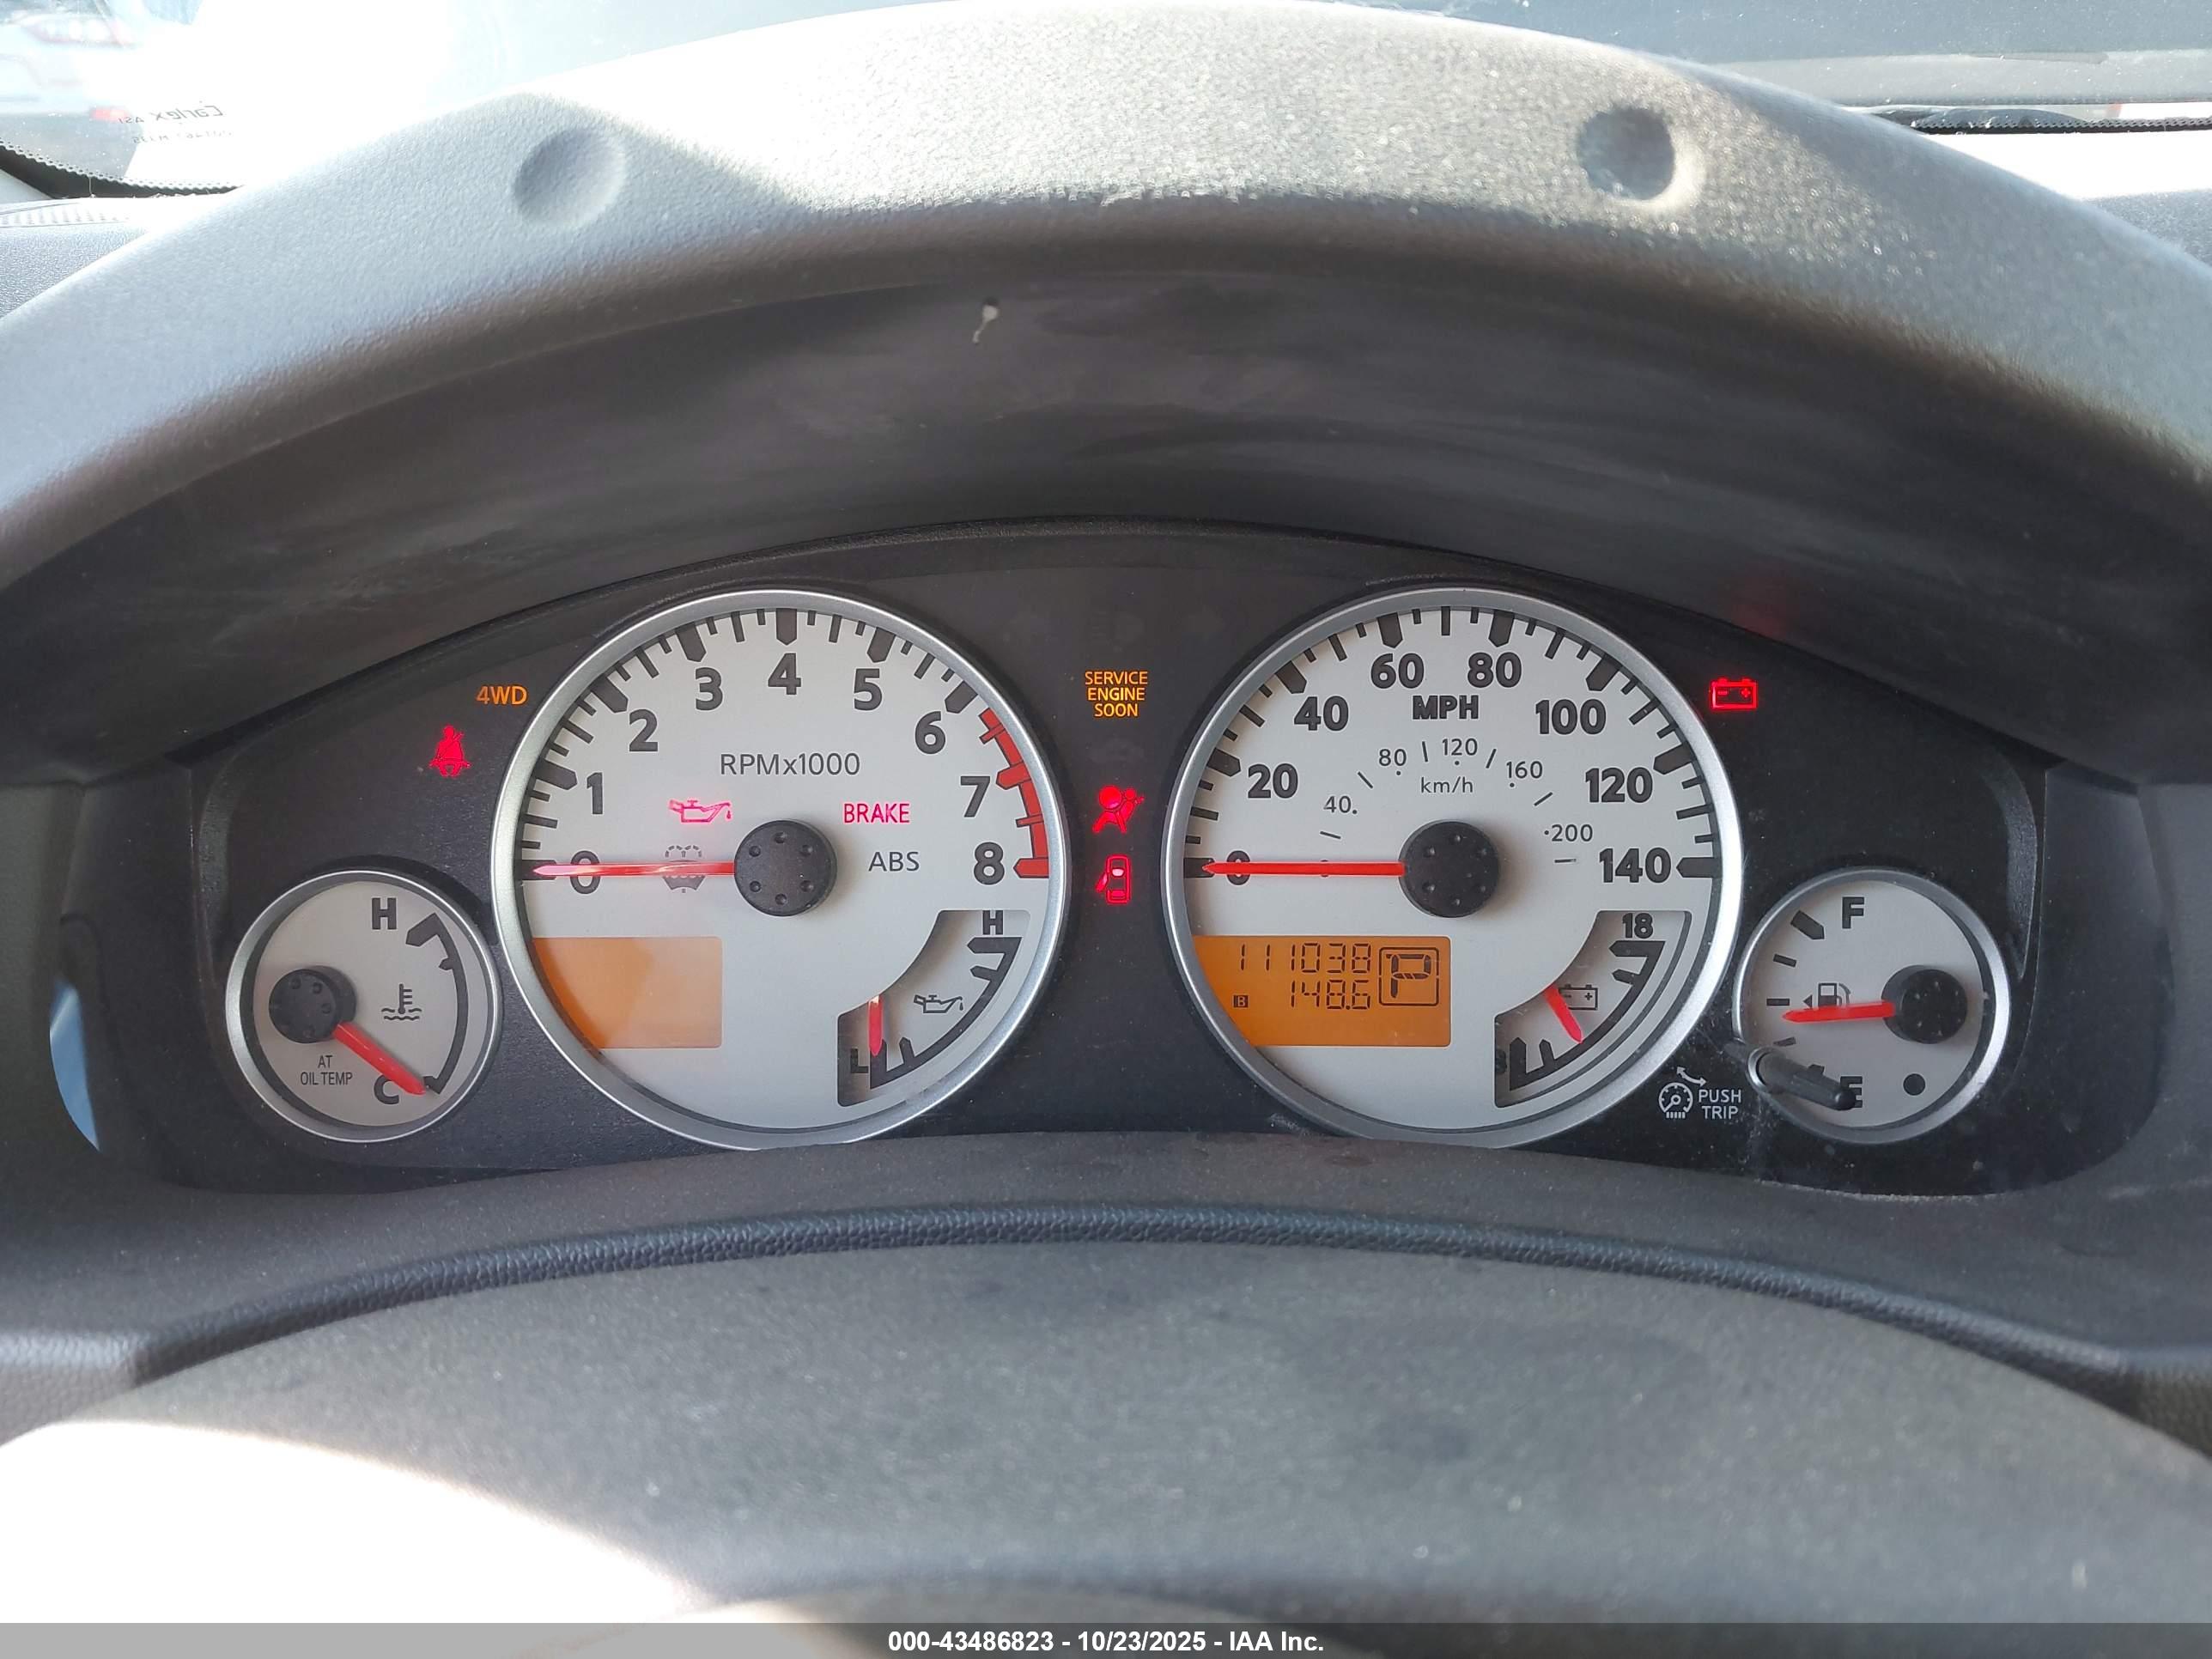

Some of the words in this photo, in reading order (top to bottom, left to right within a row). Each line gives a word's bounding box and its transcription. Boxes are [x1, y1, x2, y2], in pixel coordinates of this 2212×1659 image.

[768, 653, 802, 696] 4
[1085, 671, 1148, 685] SERVICE
[1370, 653, 1425, 689] 60
[1467, 652, 1522, 688] 80
[475, 685, 528, 705] 4WD
[695, 667, 724, 711] 3
[854, 668, 883, 711] 5
[1087, 687, 1146, 701] ENGINE
[1094, 703, 1139, 718] SOON
[1293, 696, 1349, 731] 40
[1413, 695, 1480, 720] MPH
[1535, 699, 1607, 735] 100
[629, 708, 659, 752] 2
[915, 711, 946, 754] 6
[1378, 749, 1407, 766] 80
[1442, 738, 1478, 756] 120
[720, 752, 860, 775] RPMx1000
[1506, 761, 1543, 779] 160
[586, 772, 604, 815] 1
[960, 775, 991, 817] 7
[1248, 763, 1298, 799] 20
[1421, 775, 1474, 794] km/h
[1585, 767, 1653, 803] 120
[843, 803, 910, 823] BRAKE
[1323, 796, 1351, 813] 40
[1551, 823, 1593, 842] 200
[570, 850, 600, 894] 0
[868, 851, 920, 872] ABS
[973, 842, 1005, 885] 8
[1226, 850, 1250, 885] 0
[1599, 847, 1671, 883] 140
[371, 897, 397, 930] H
[982, 910, 1003, 935] H
[1622, 912, 1654, 939] 18
[1842, 896, 1864, 929] F
[1241, 943, 1371, 973] 111038
[1385, 953, 1431, 999] P
[1291, 979, 1371, 1010] 148.6
[318, 1055, 332, 1068] AT
[850, 1048, 868, 1073] L
[301, 1072, 318, 1085] OIL
[322, 1072, 353, 1085] TEMP
[374, 1073, 399, 1105] C
[1839, 1076, 1863, 1108] E
[1698, 1089, 1741, 1103] PUSH
[1701, 1105, 1739, 1119] TRIP
